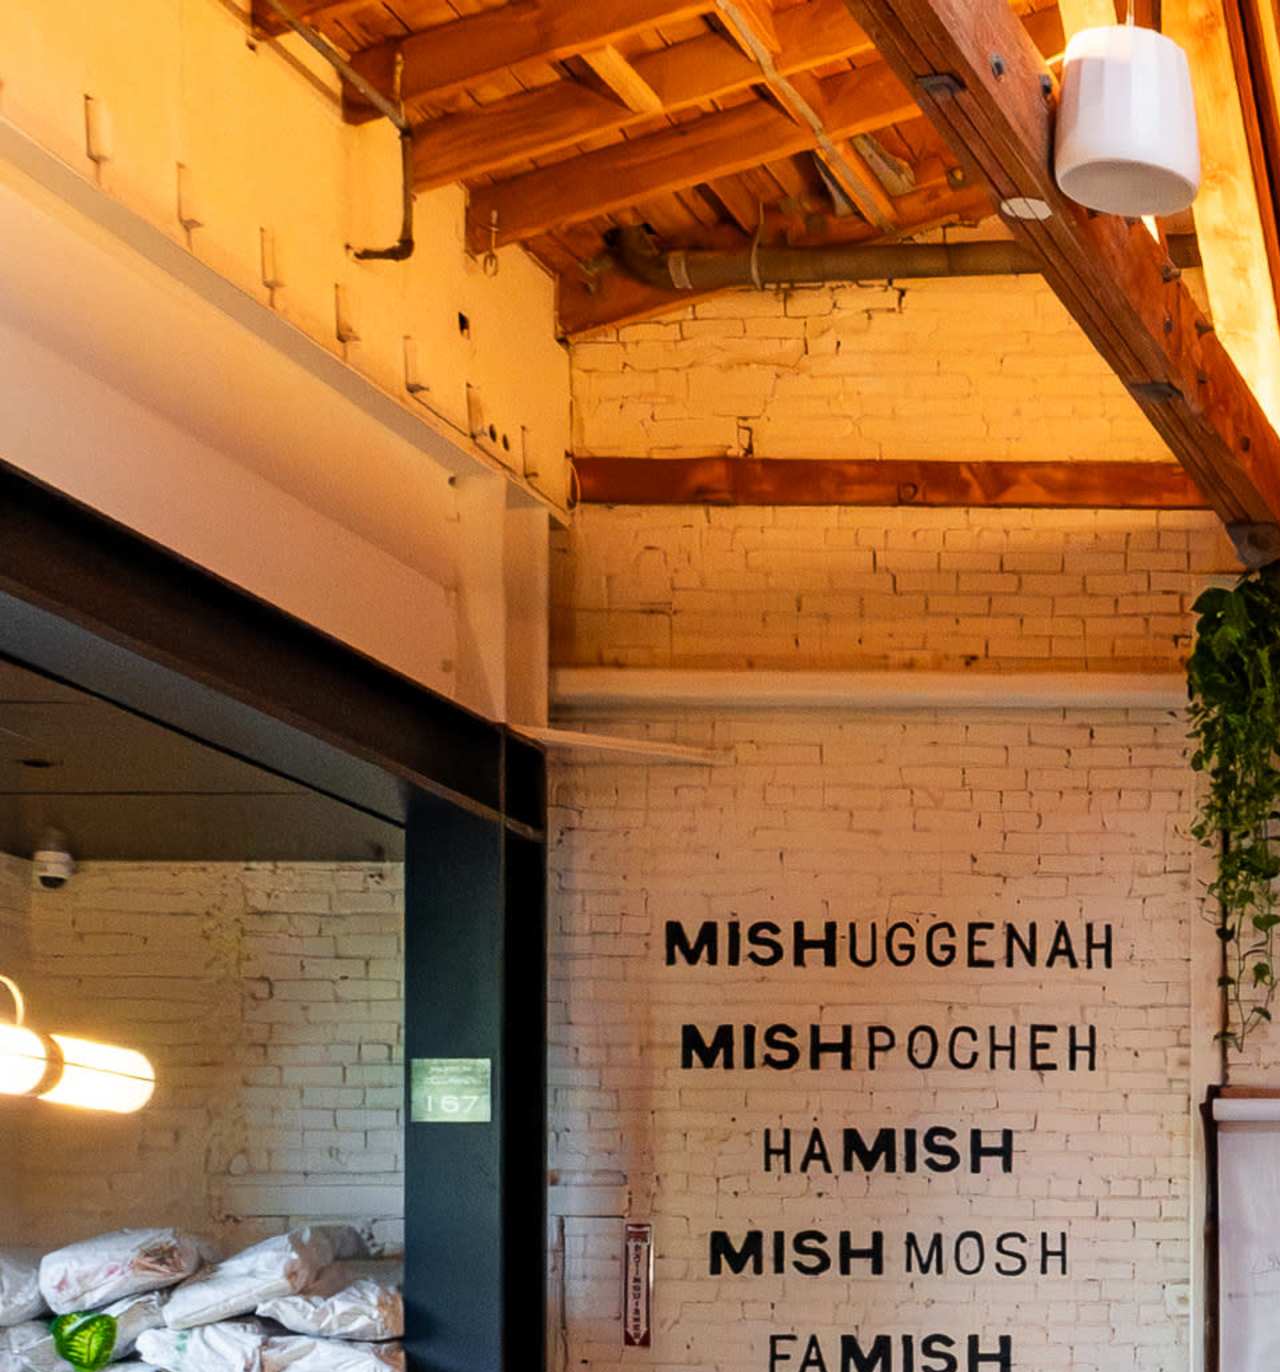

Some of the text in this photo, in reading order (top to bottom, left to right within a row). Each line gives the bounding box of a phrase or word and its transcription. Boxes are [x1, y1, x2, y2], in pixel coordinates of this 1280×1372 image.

[665, 920, 1114, 970] MISHUGGENAH
[680, 1023, 1097, 1072] MISHPOCHEH
[426, 1095, 481, 1113] 167
[764, 1127, 1014, 1174] HAMISH
